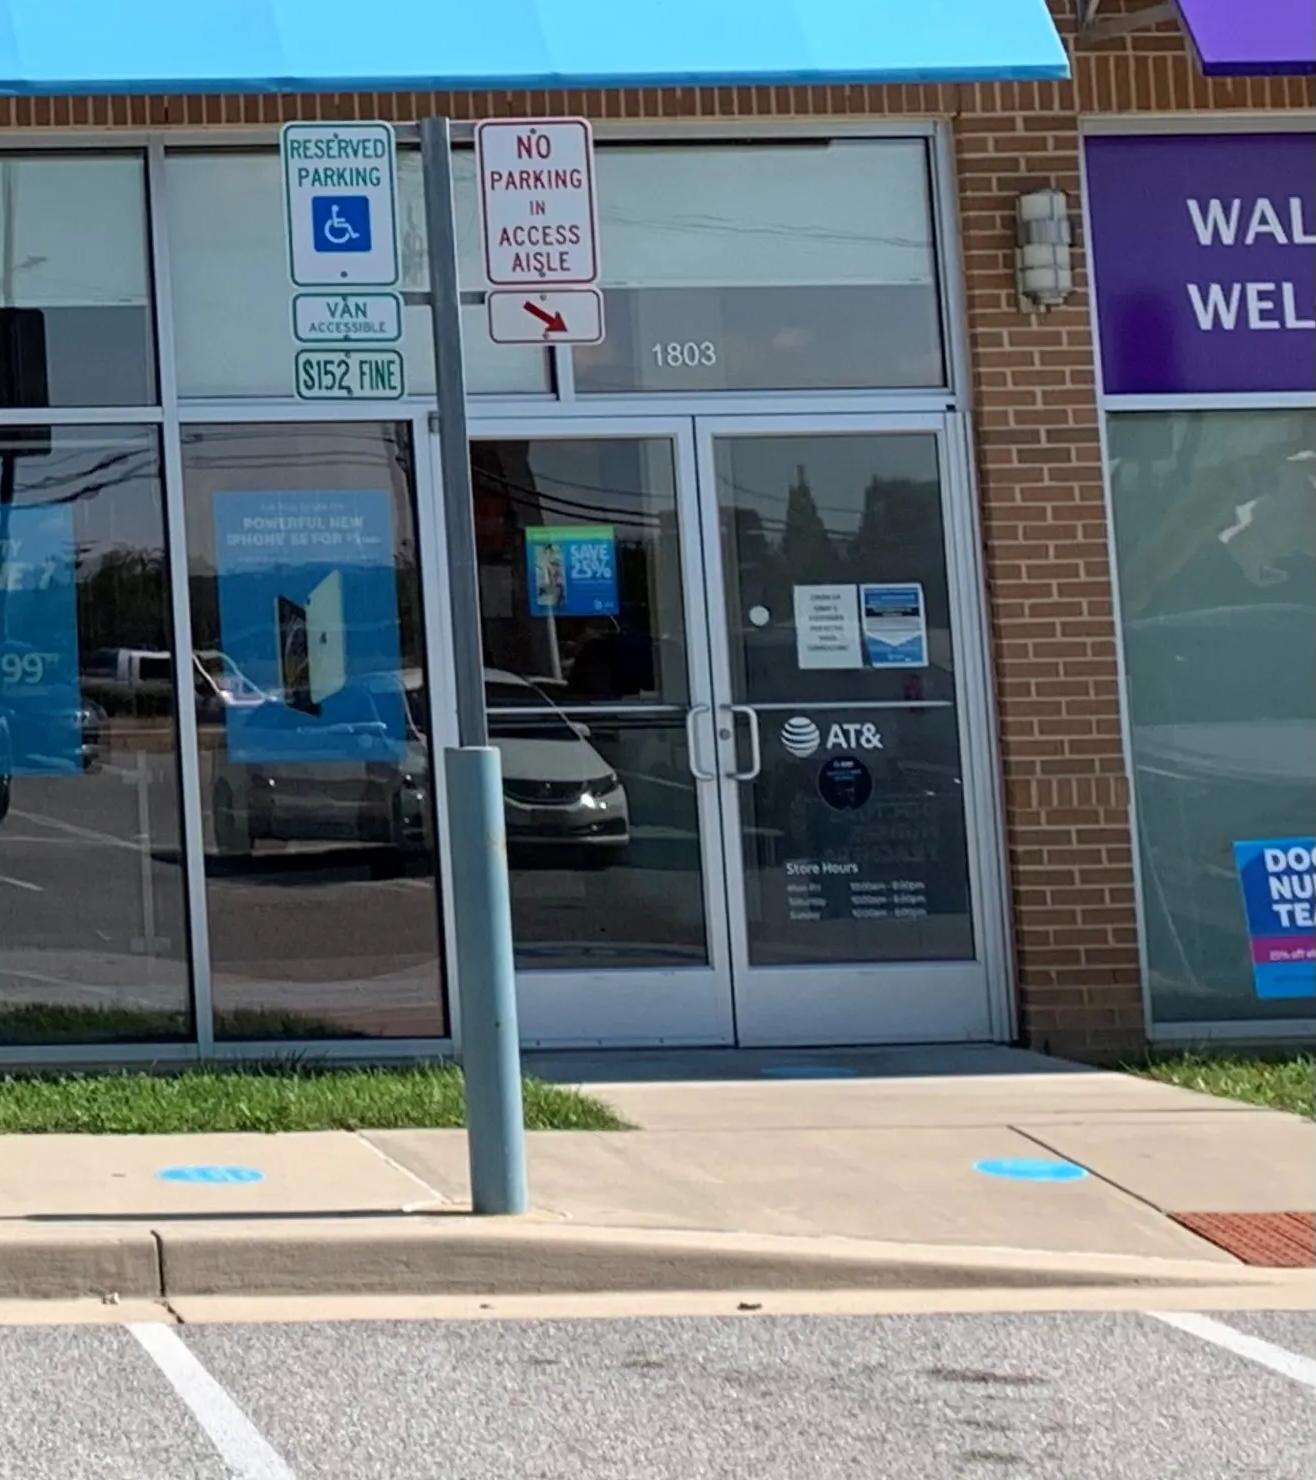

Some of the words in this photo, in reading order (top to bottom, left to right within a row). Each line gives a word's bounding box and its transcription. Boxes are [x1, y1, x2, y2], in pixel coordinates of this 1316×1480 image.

[289, 138, 386, 160] RESERVED
[516, 134, 552, 160] NO
[297, 166, 381, 188] PARKING
[490, 168, 583, 190] PARKING
[529, 200, 546, 216] IN
[1186, 197, 1316, 246] WAL
[498, 225, 580, 247] ACCESS
[511, 252, 571, 273] AISLE
[326, 302, 368, 320] VAN
[1186, 281, 1316, 331] WEL
[308, 321, 387, 335] ACCESSIBLE
[651, 342, 717, 368] 1803
[302, 359, 351, 393] $152
[359, 359, 398, 392] FINE
[243, 516, 326, 531] POWERFUL
[570, 543, 610, 560] SAVE
[570, 559, 612, 579] 25%
[785, 862, 820, 875] Store
[821, 861, 859, 875] Hours
[1263, 846, 1316, 873] DO
[1269, 873, 1316, 901] NU
[1272, 902, 1316, 929] TE
